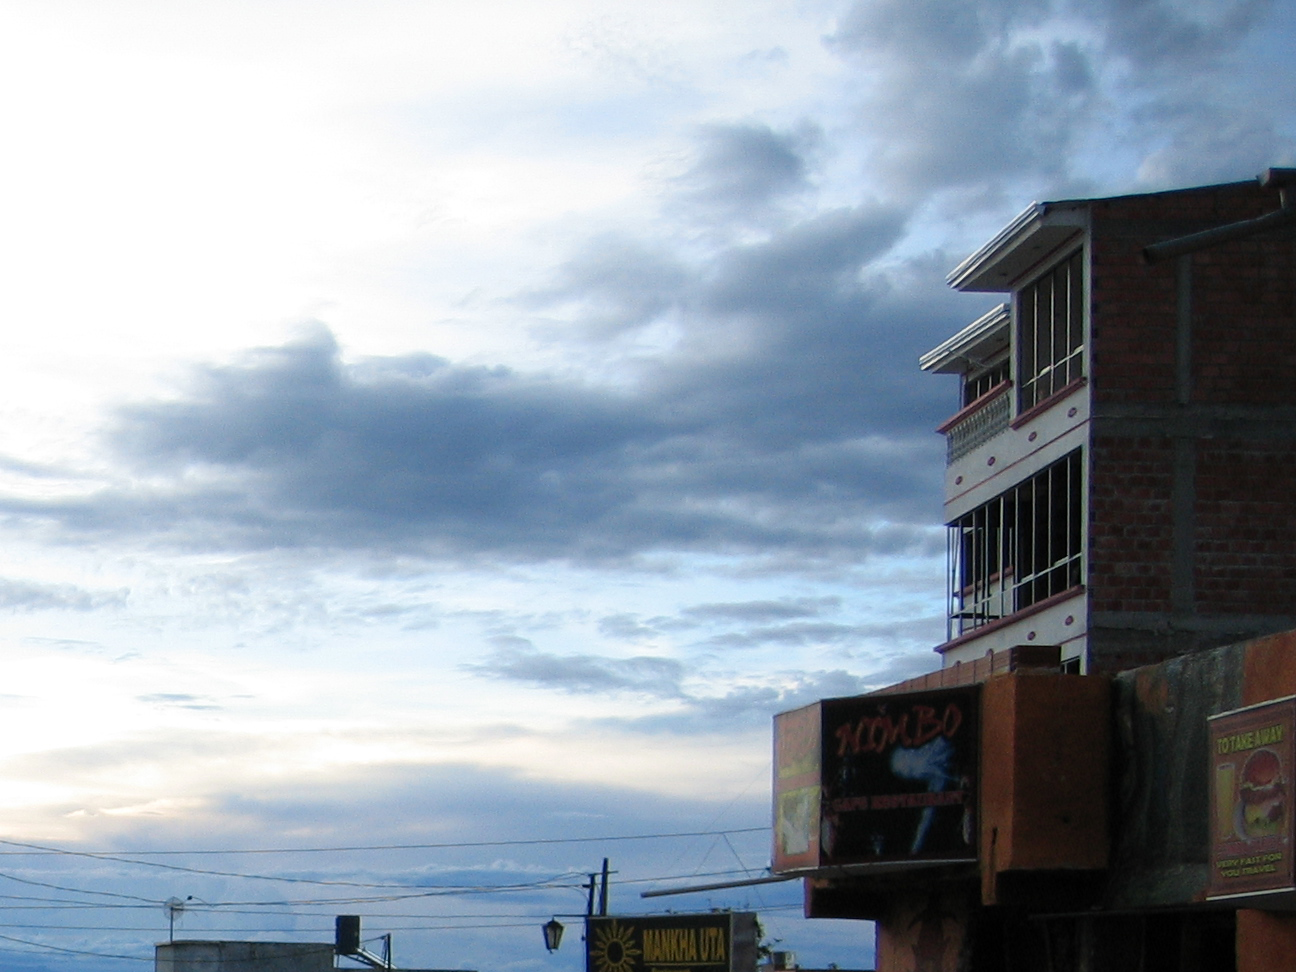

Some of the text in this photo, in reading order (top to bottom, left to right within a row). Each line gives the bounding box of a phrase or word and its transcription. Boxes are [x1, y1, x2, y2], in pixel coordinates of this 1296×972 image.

[835, 703, 963, 757] NIMBO
[1217, 724, 1284, 754] TO TAKE AWAY
[1216, 859, 1239, 869] VERY
[1264, 853, 1283, 863] FOR
[1221, 869, 1240, 878] YOU
[643, 927, 726, 962] MANKHA UTA
